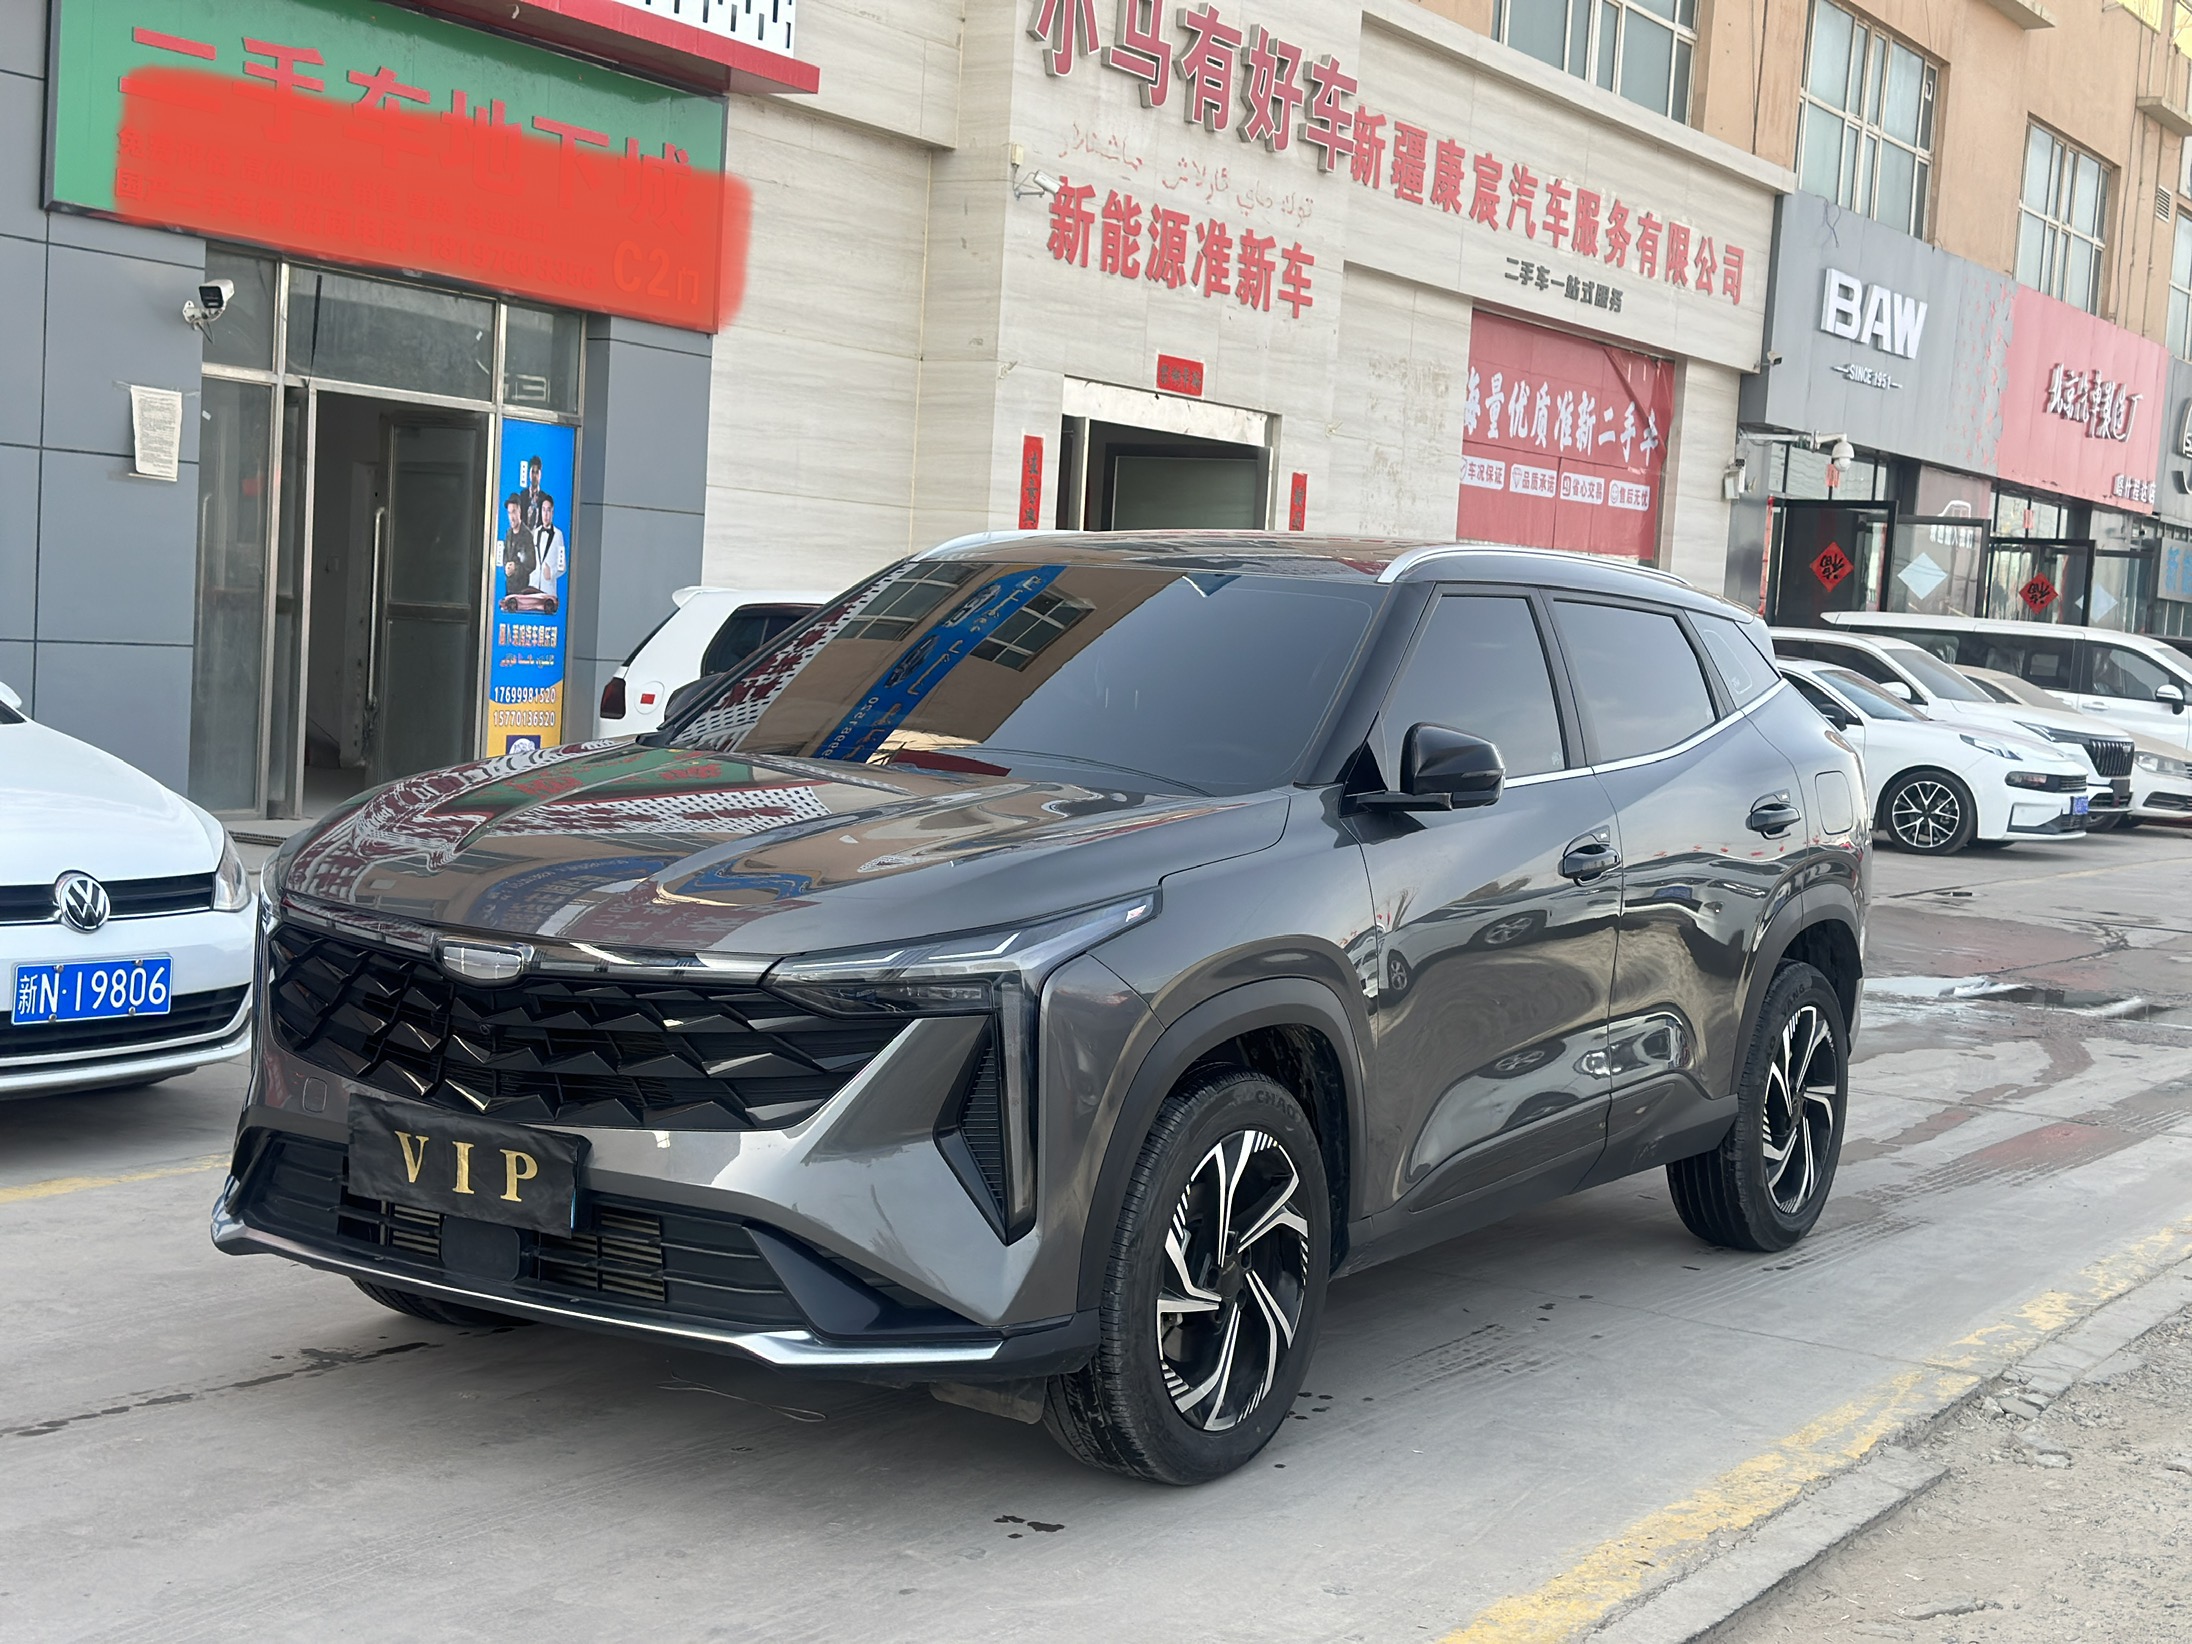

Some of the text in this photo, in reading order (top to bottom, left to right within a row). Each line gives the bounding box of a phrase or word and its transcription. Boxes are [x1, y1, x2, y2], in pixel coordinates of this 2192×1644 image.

[1030, 0, 1358, 172] 小马有好车
[1351, 105, 1744, 305] 新疆康宸汽车服务有限公司
[1047, 176, 1315, 319] 新能源准新车
[1504, 256, 1623, 313] 二手车一站式服务
[1821, 268, 1928, 360] BAW
[1849, 364, 1892, 390] SINCE 1951
[1467, 461, 1505, 487] 车况保证
[1521, 468, 1557, 493] 品质承诺
[1619, 486, 1649, 508] 售后无忧
[494, 686, 556, 704] 17699981520
